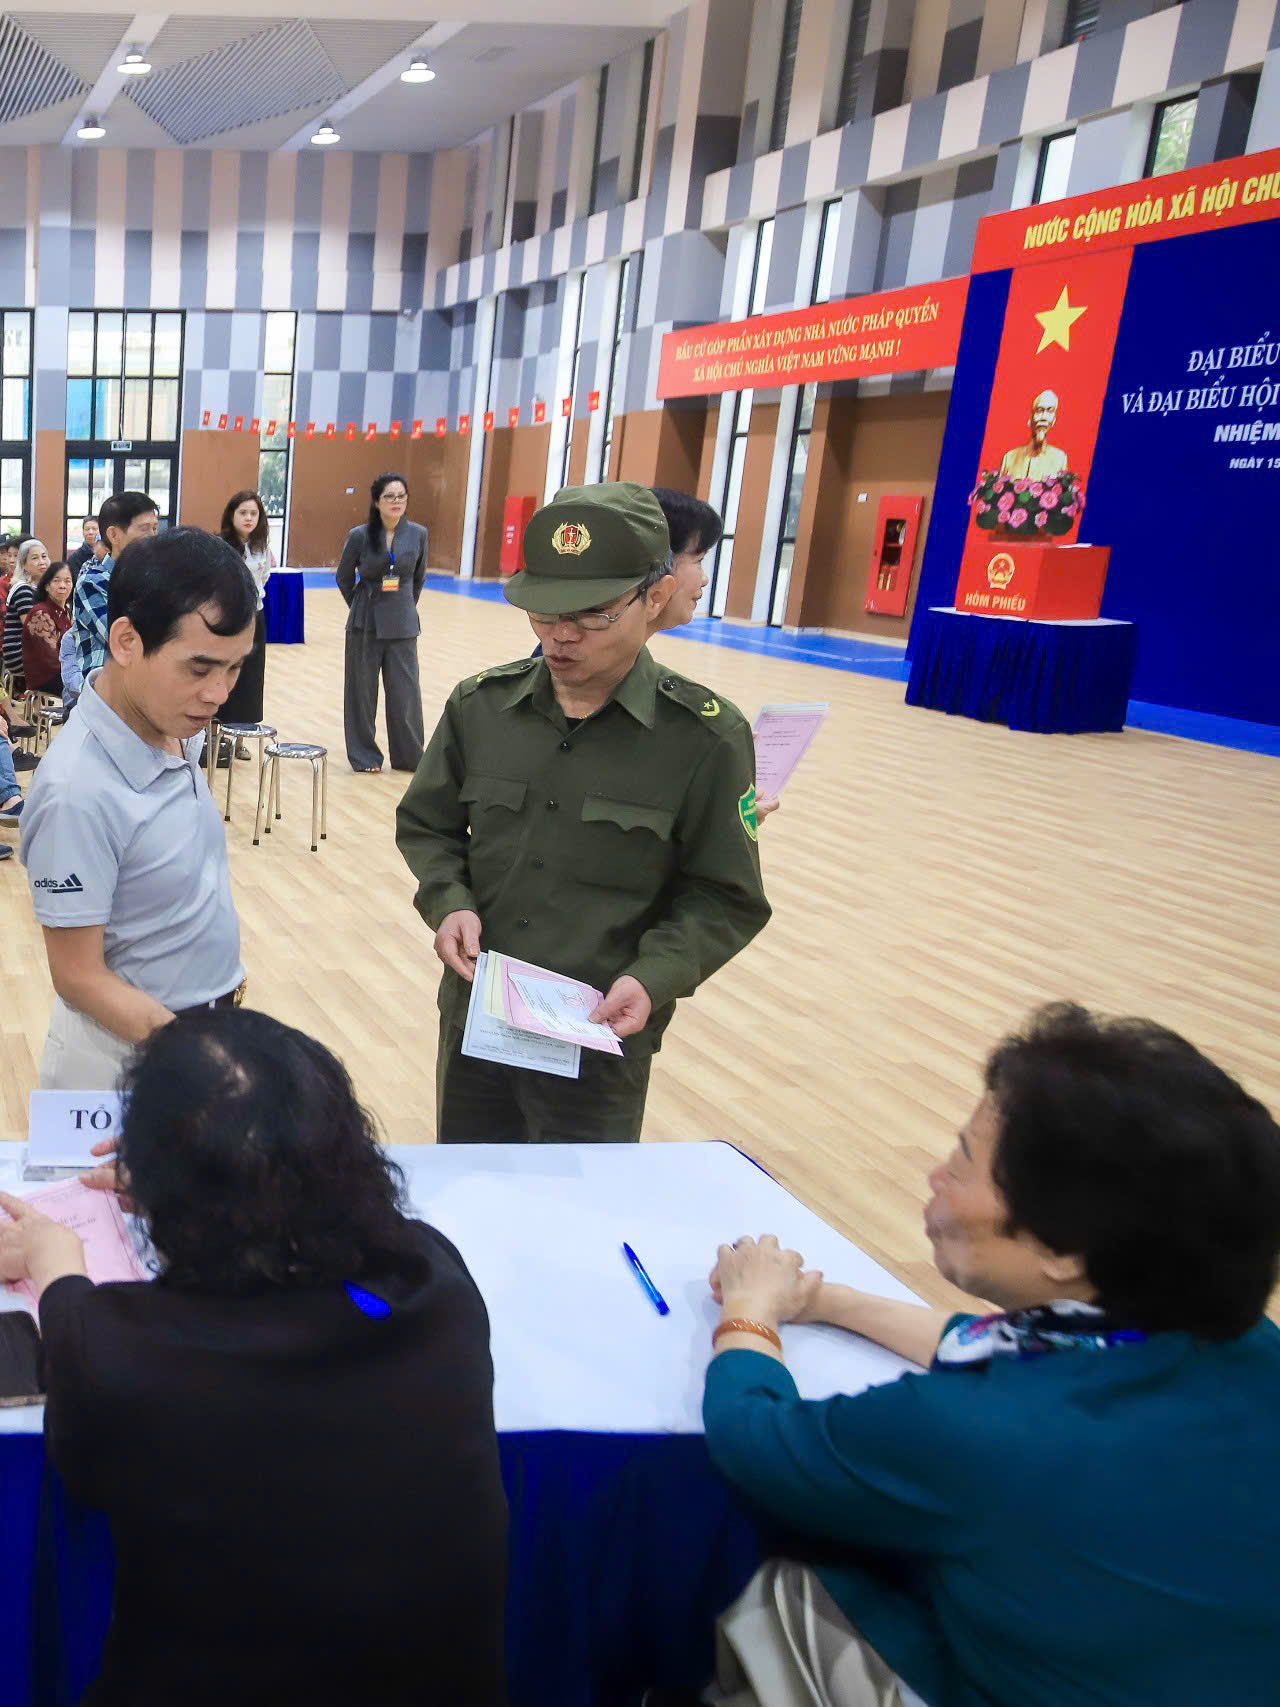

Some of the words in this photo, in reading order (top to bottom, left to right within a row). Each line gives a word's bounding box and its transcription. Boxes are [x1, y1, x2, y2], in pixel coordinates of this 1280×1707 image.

[1023, 216, 1070, 249] NƯỚC
[1072, 207, 1122, 242] CỘNG
[1123, 194, 1164, 230] HÒA
[1167, 184, 1197, 221] XÃ
[1199, 177, 1238, 216] HỘI
[803, 319, 826, 341] NHÀ
[828, 314, 860, 338] NƯỚC
[861, 307, 894, 332] PHÁP
[895, 296, 940, 328] QUYỀN
[777, 350, 800, 373] VIỆT
[800, 349, 825, 368] NAM
[859, 339, 895, 363] MẠNH
[1186, 347, 1225, 376] ĐẠI
[1227, 331, 1280, 369] BIỂU
[1122, 386, 1144, 414] VÀ
[1147, 389, 1183, 417] ĐẠI
[1185, 375, 1237, 410] BIỂU
[1238, 376, 1280, 412] HỘI
[1213, 419, 1280, 445] NHIỆM
[1229, 456, 1264, 469] NGÀY
[964, 590, 990, 608] HÒM
